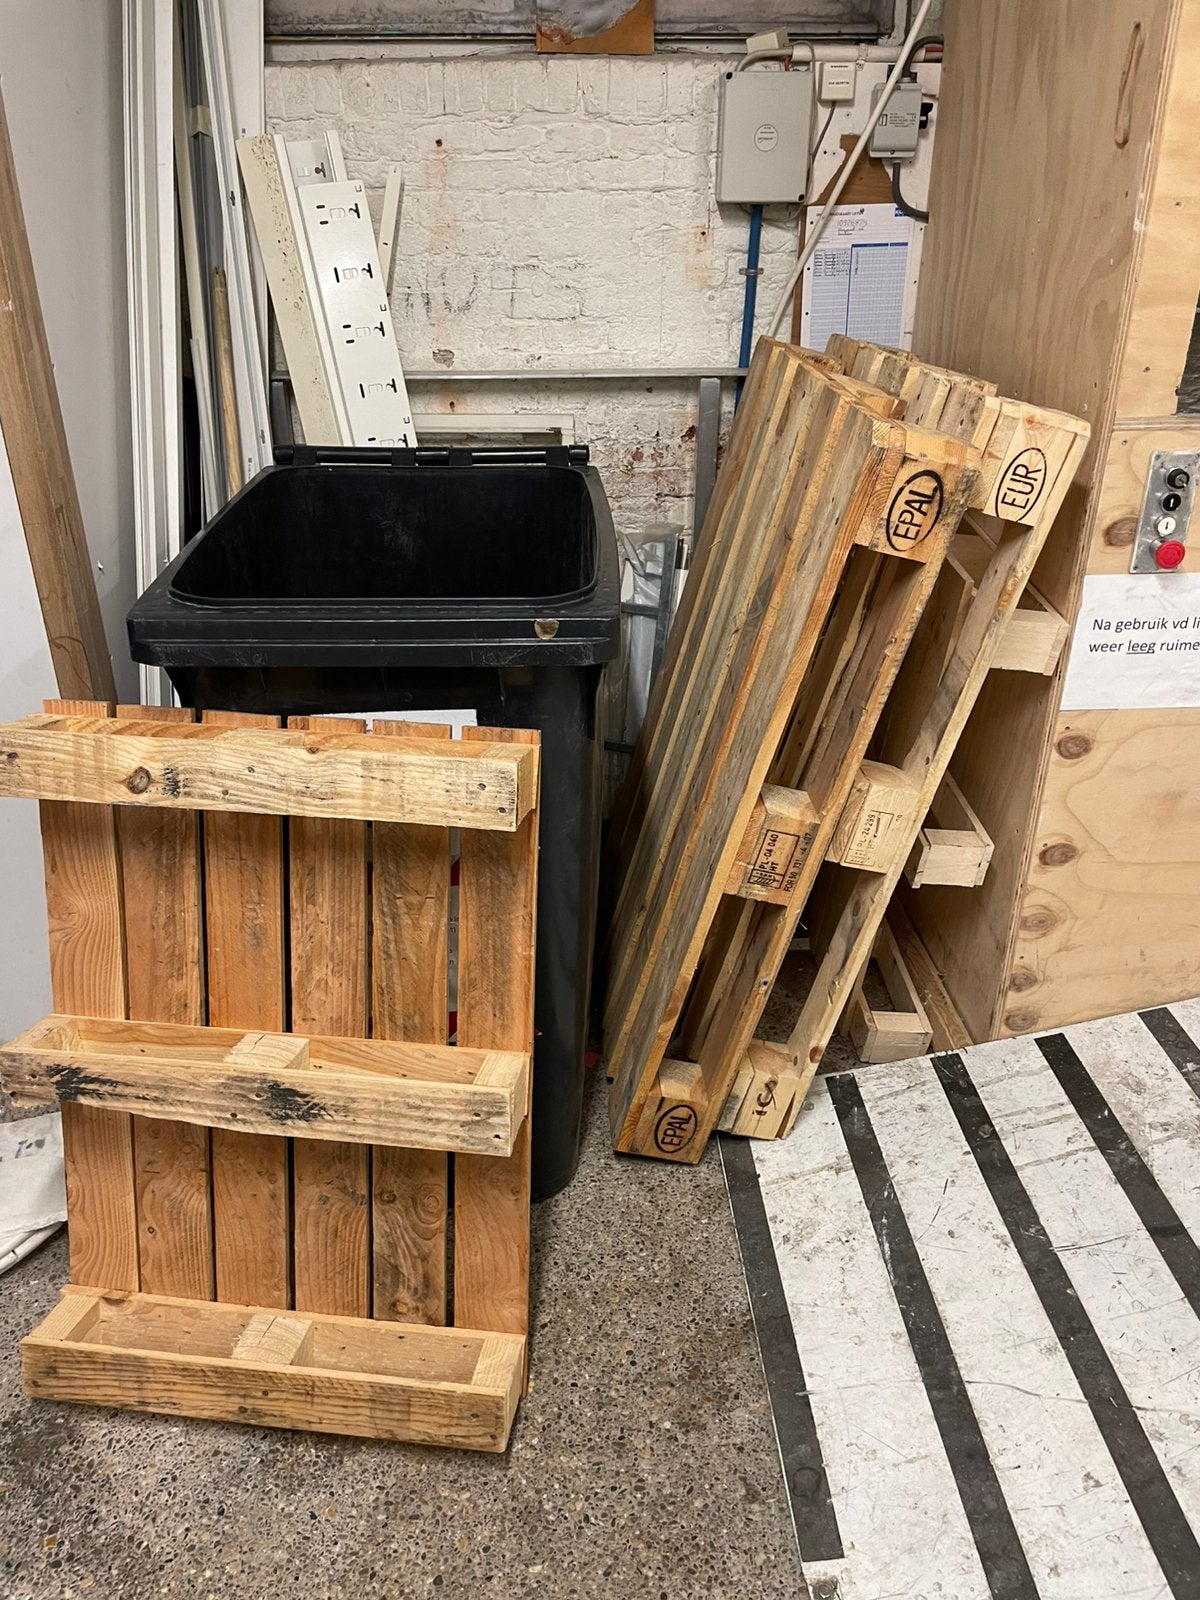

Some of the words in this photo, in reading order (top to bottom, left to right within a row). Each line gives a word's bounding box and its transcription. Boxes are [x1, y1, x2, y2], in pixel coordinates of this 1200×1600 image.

[1001, 463, 1042, 509] EUR
[892, 485, 939, 541] EPAL
[1092, 619, 1111, 630] Na
[1114, 617, 1168, 633] gebruik
[1172, 617, 1189, 629] vd
[1089, 642, 1124, 652] weer
[1126, 640, 1156, 654] leeg
[769, 861, 779, 872] HT
[661, 1113, 693, 1147] EPAL
